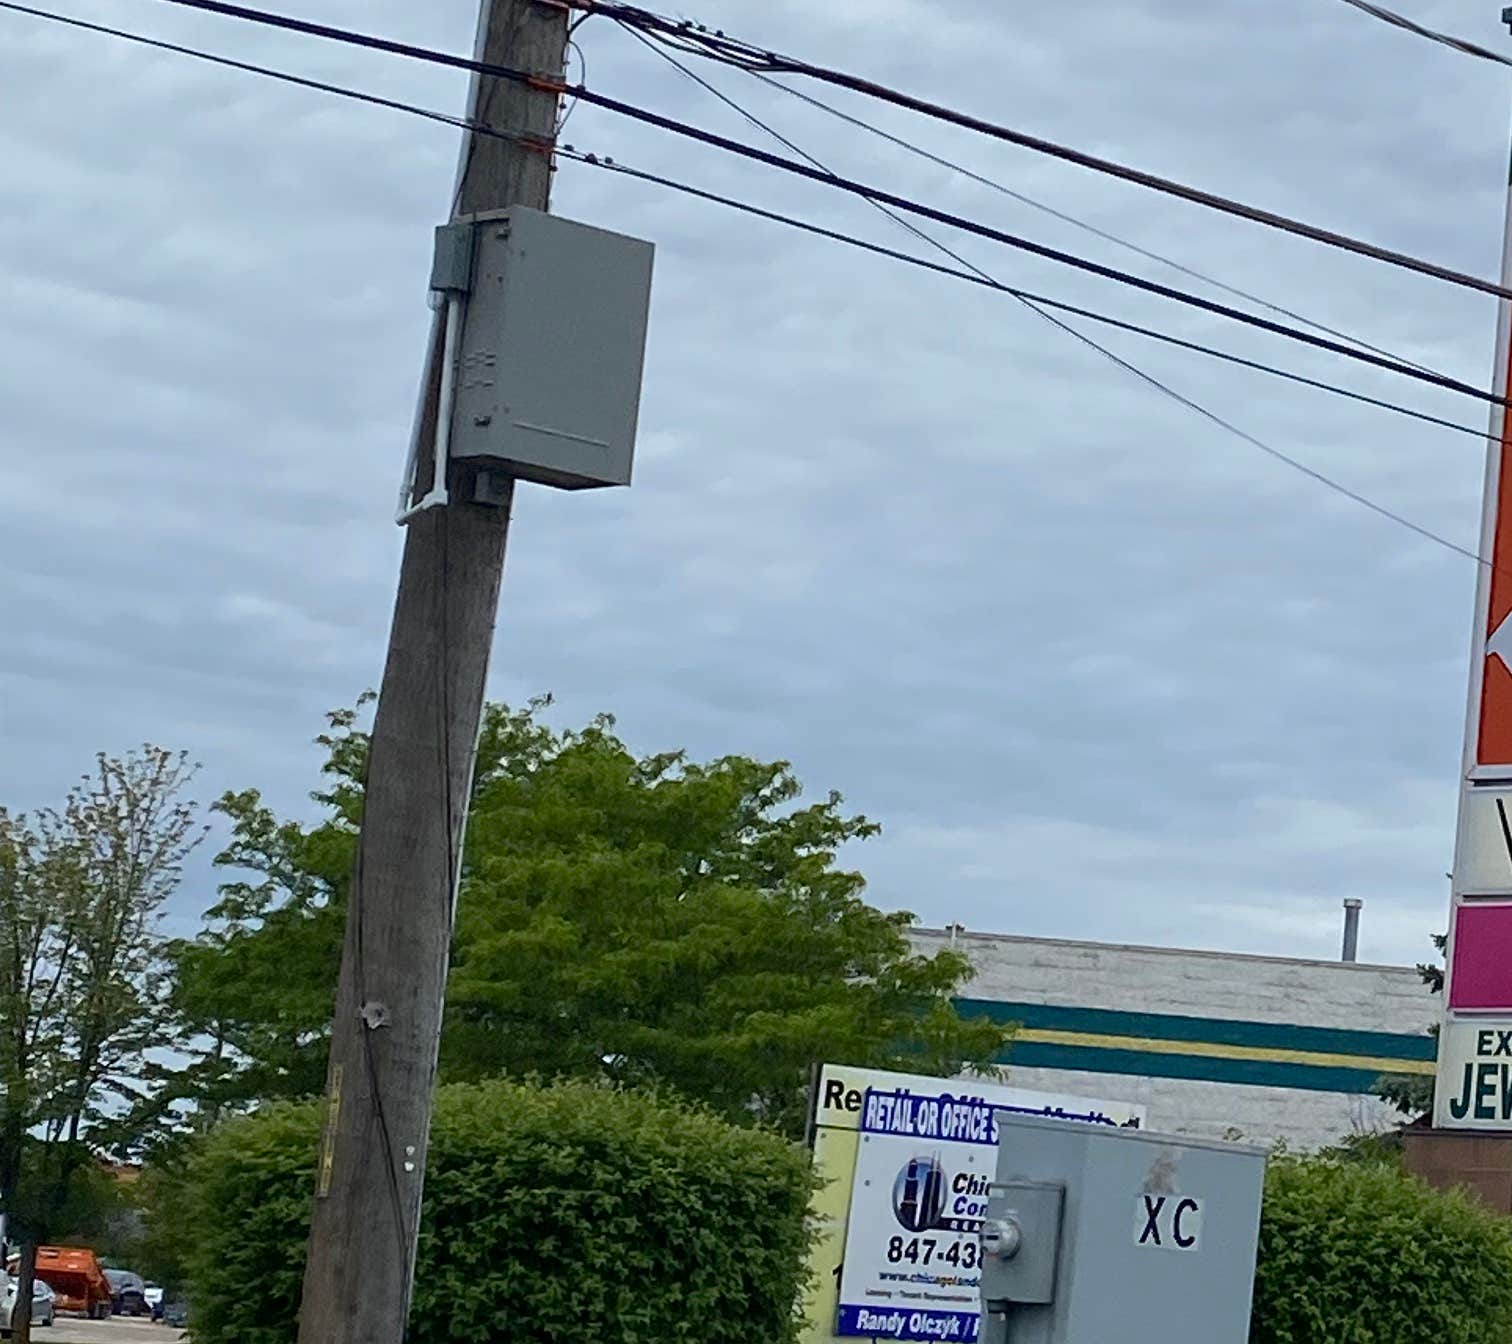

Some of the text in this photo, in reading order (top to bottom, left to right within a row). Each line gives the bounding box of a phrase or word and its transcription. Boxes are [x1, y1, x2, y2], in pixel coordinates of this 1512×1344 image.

[865, 1094, 915, 1134] RETAIL
[916, 1102, 939, 1136] OR
[941, 1105, 991, 1141] OFFICE
[856, 1309, 906, 1337] Randy
[909, 1312, 961, 1339] Olczyk
